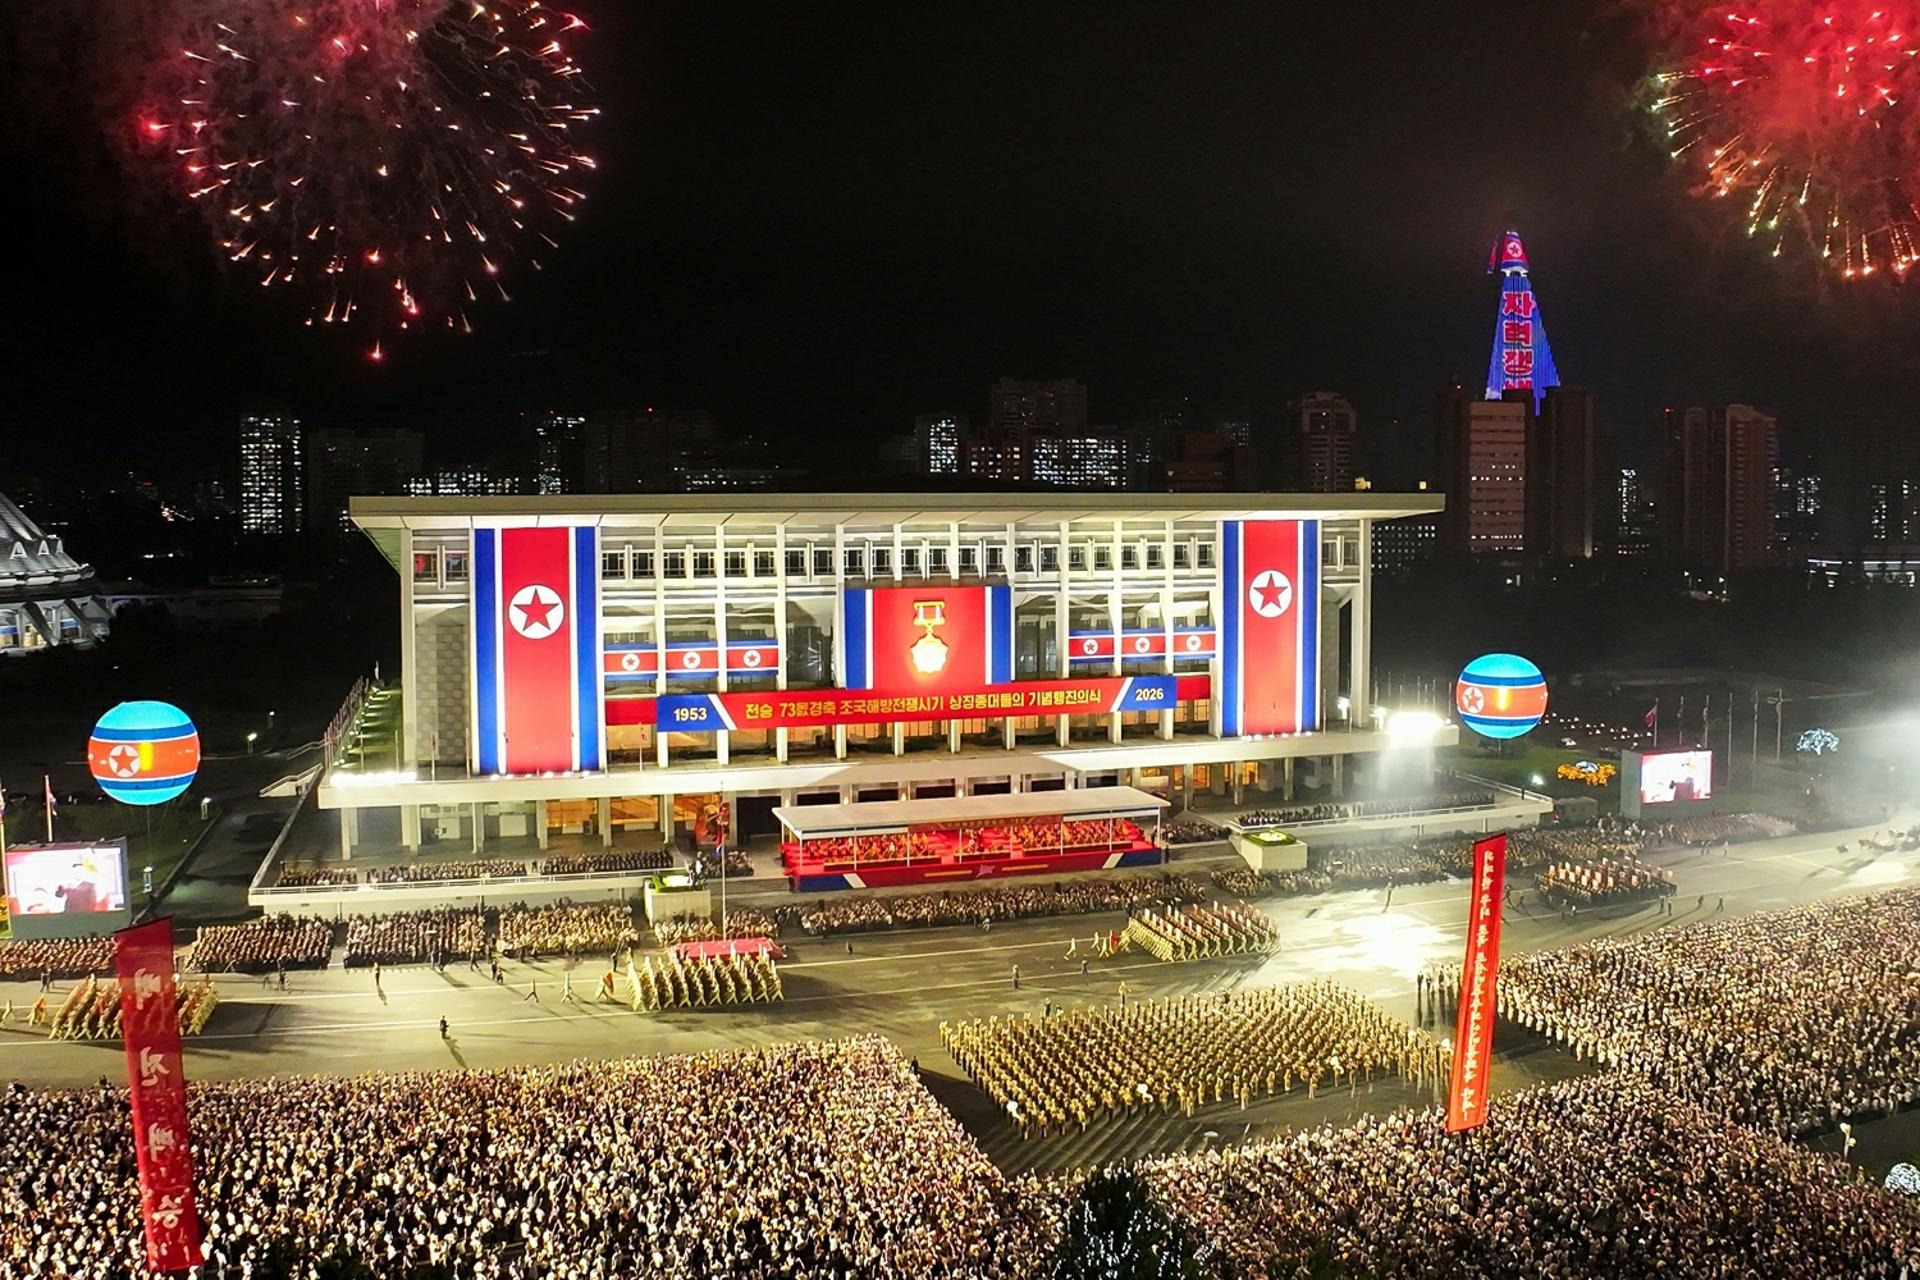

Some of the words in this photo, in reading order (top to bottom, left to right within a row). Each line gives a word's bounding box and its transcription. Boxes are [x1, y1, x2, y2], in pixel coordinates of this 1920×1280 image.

[1135, 688, 1164, 701] 2026
[745, 703, 773, 720] 전승
[839, 696, 944, 715] 조국해방전쟁시기
[1028, 689, 1102, 707] 기념행진의식
[673, 707, 708, 721] 1953
